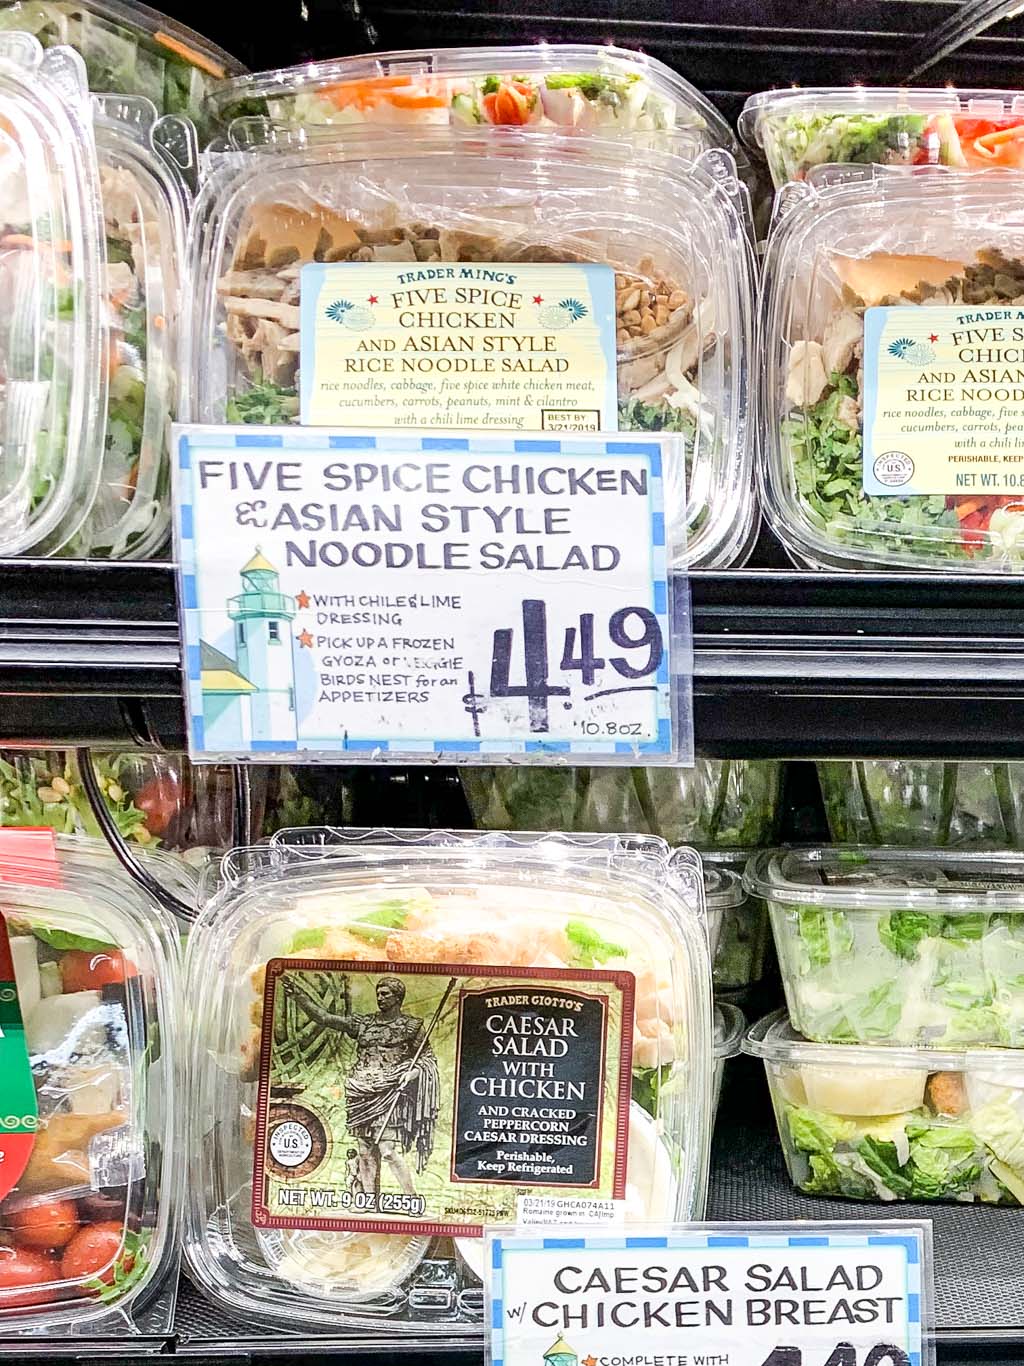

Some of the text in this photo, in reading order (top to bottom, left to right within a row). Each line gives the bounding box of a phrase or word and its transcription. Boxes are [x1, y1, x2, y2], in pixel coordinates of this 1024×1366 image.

[392, 288, 523, 309] FIVE SPICE
[399, 312, 515, 329] CHICKEN
[957, 312, 1011, 325] TRADER
[357, 336, 557, 352] AND ASIAN STYLE
[344, 358, 569, 373] RICE NOODLE SALAD
[883, 410, 901, 418] rice
[905, 407, 946, 419] noodles,
[950, 407, 995, 420] cabbage,
[200, 460, 648, 496] FIVE SPICE CHICKEN
[421, 505, 571, 535] STYLE
[285, 541, 621, 572] NOODLE SALAD
[486, 997, 583, 1011] TRADER GIOTTO'S
[486, 1015, 577, 1038] CAESAR
[493, 1037, 568, 1057] SALAD
[503, 1062, 554, 1078] WITH
[470, 1078, 585, 1101] CHICKEN
[478, 1106, 576, 1119] AND CRACKED
[484, 1120, 569, 1132] PEPPERCORN
[464, 1131, 587, 1146] CAESAR DRESSING
[497, 1151, 554, 1163] Perishable,
[477, 1162, 573, 1174] Keep Refrigerated
[278, 1189, 309, 1206] NET
[311, 1191, 339, 1207] WT.
[342, 1194, 352, 1208] 9
[354, 1193, 376, 1209] OZ
[378, 1194, 425, 1215] (255g)
[553, 1264, 883, 1293] CAESAR SALAD
[531, 1297, 903, 1328] CHICKEN BREAST
